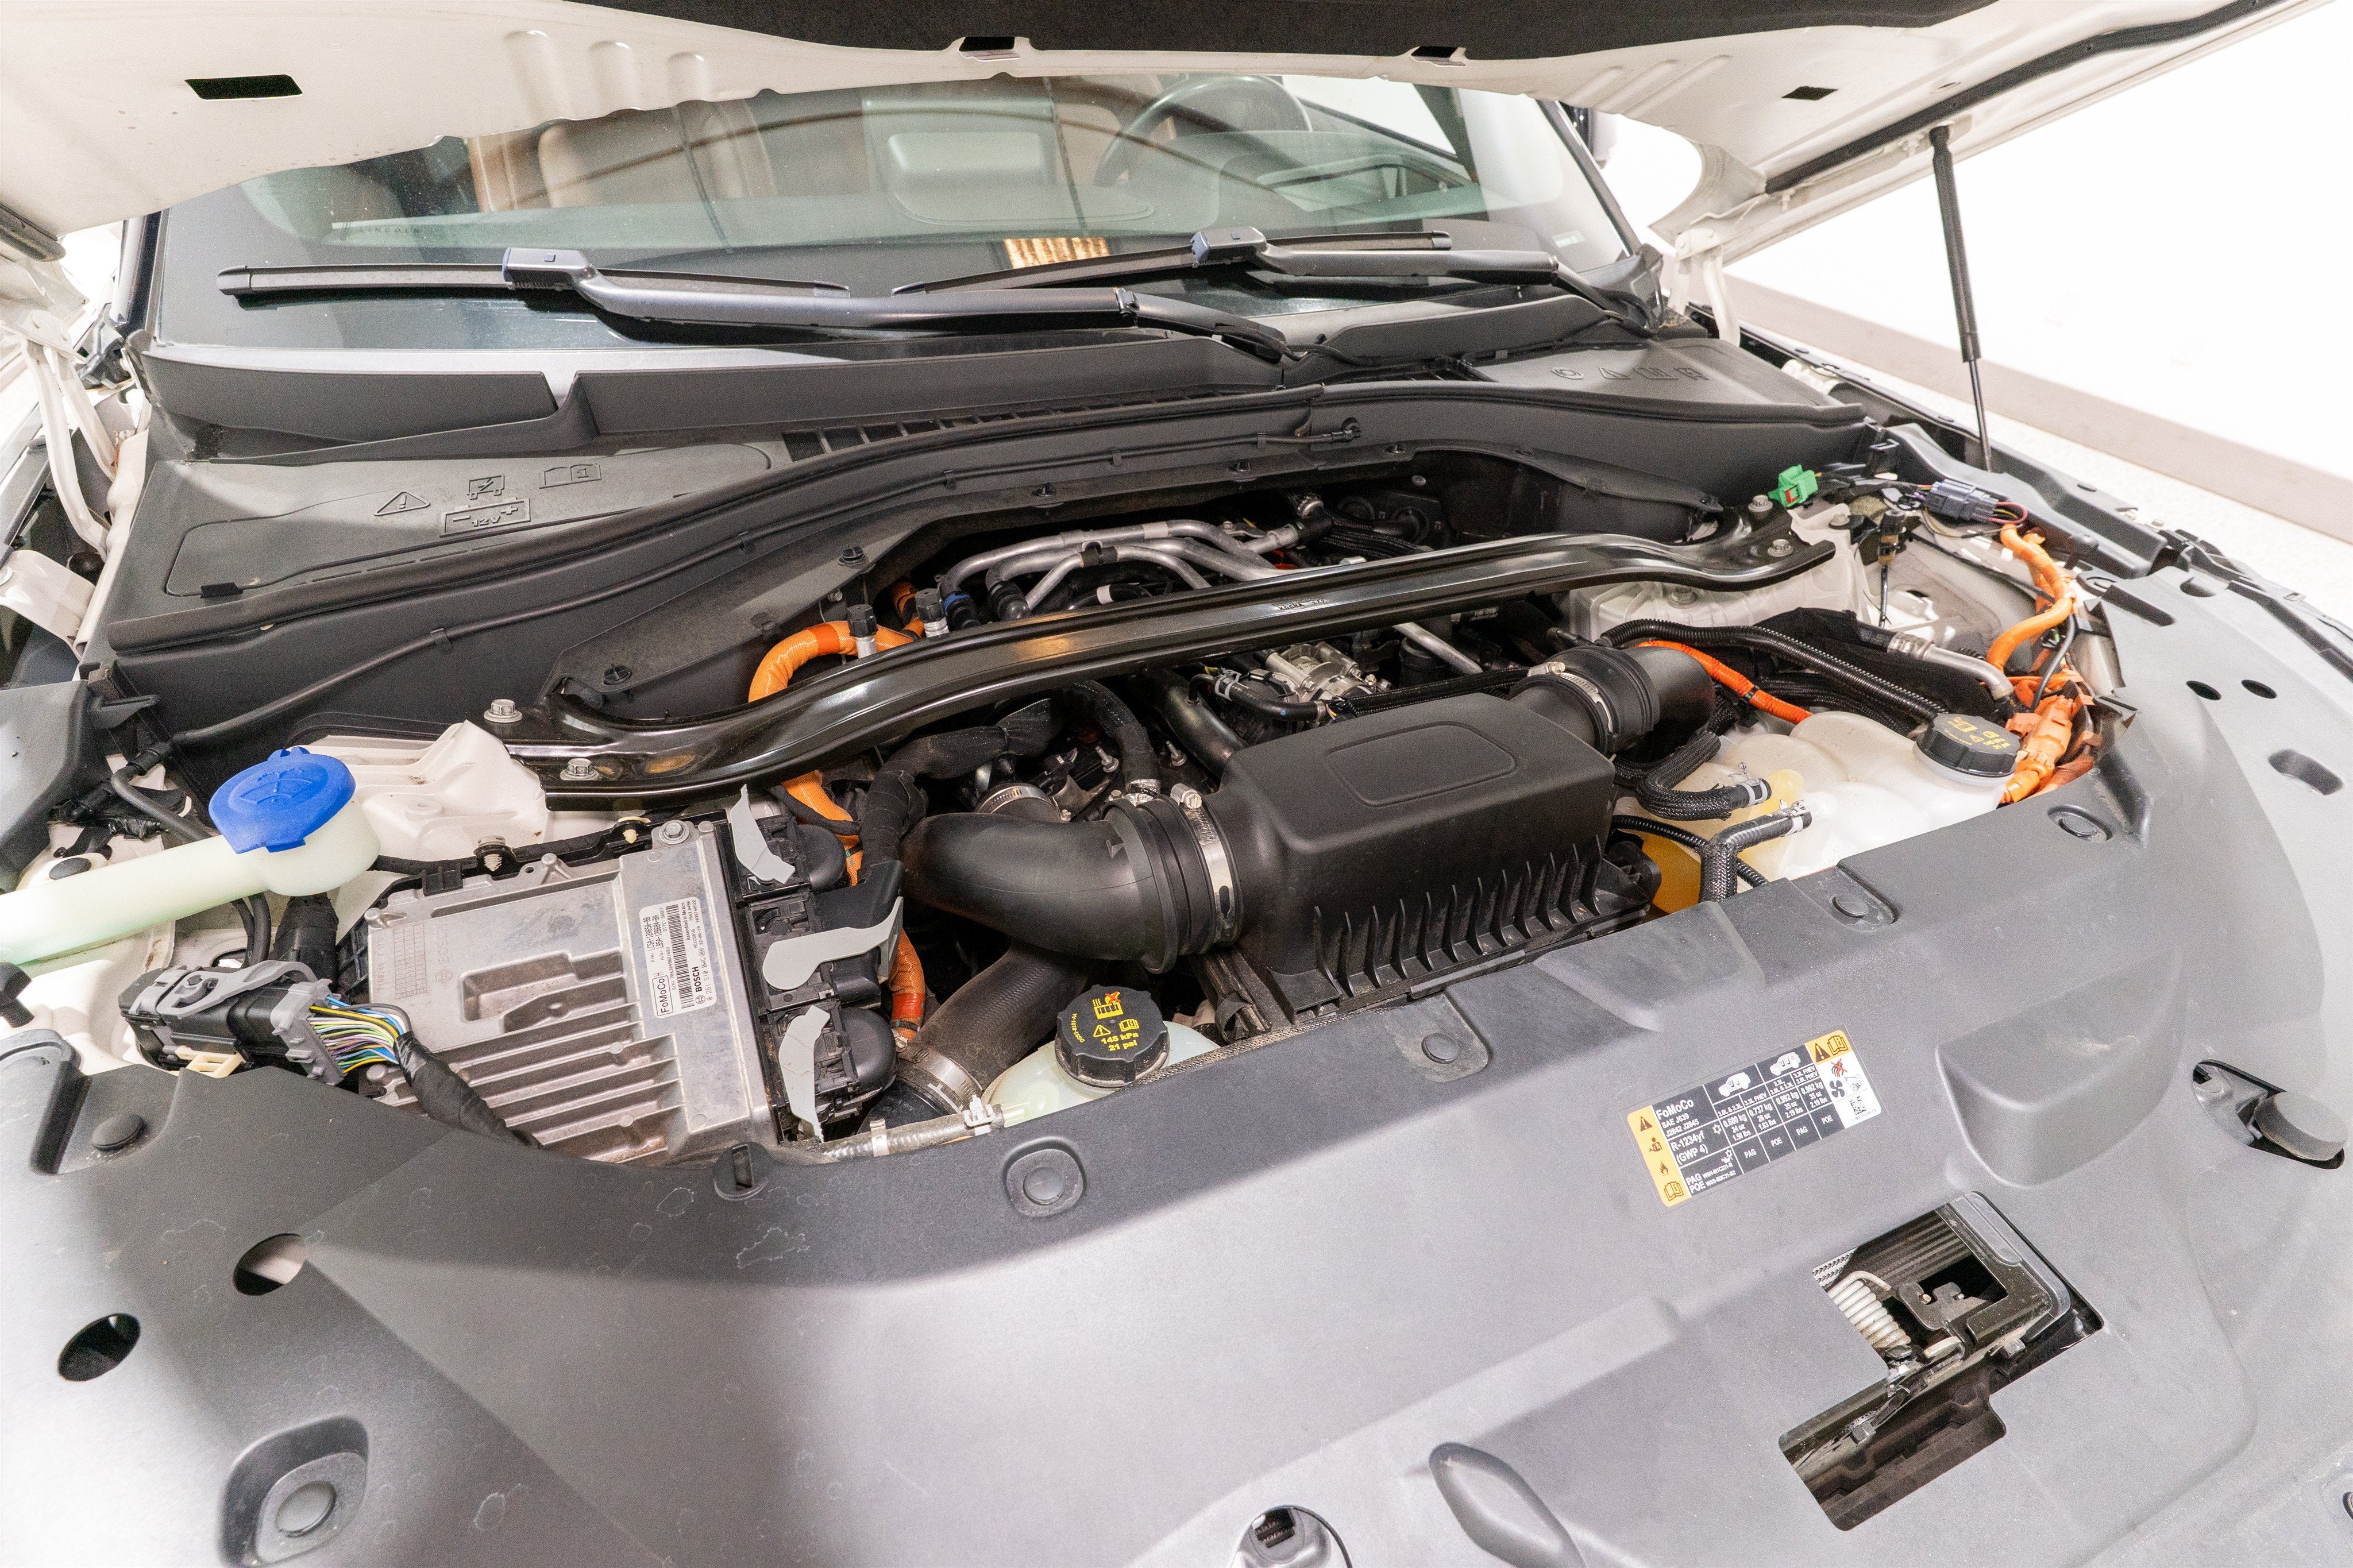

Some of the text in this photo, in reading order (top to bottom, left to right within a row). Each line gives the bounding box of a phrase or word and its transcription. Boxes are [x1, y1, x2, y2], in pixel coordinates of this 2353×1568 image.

[471, 516, 501, 527] 12V
[691, 966, 702, 992] BOSCH
[656, 978, 669, 1013] FoMoCo
[1101, 1033, 1139, 1044] 145 kPa
[1123, 1040, 1137, 1049] psi
[1792, 1065, 1816, 1079] 3.3L FHEV
[1804, 1071, 1819, 1080] PHEV
[1800, 1079, 1824, 1095] 0.992 kg
[1743, 1091, 1767, 1106] 3.3L FHEV
[1775, 1089, 1800, 1106] 0.992 kg
[1808, 1092, 1816, 1100] 35
[1809, 1095, 1828, 1108] 2.19 lbs
[1654, 1096, 1695, 1121] FoMoCo
[1748, 1101, 1773, 1117] 0.737 kg
[1783, 1102, 1792, 1110] 35
[1784, 1105, 1804, 1119] 2.19 lbs
[1661, 1112, 1689, 1129] SAE J639
[1722, 1111, 1748, 1128] 0.680 kg
[1757, 1117, 1777, 1130] 1.63 lbs
[1820, 1114, 1833, 1125] POE
[1664, 1118, 1699, 1137] J2842 J2845
[1730, 1125, 1739, 1133] 24
[1795, 1125, 1808, 1136] PAG
[1731, 1128, 1752, 1141] 1.50 lbs
[1669, 1130, 1706, 1153] R-1234yf
[1770, 1136, 1783, 1147] POE
[1675, 1142, 1709, 1165] (GWP 4)
[1743, 1148, 1757, 1158] PAG
[1685, 1172, 1702, 1185] PAG
[1688, 1180, 1706, 1194] POE
